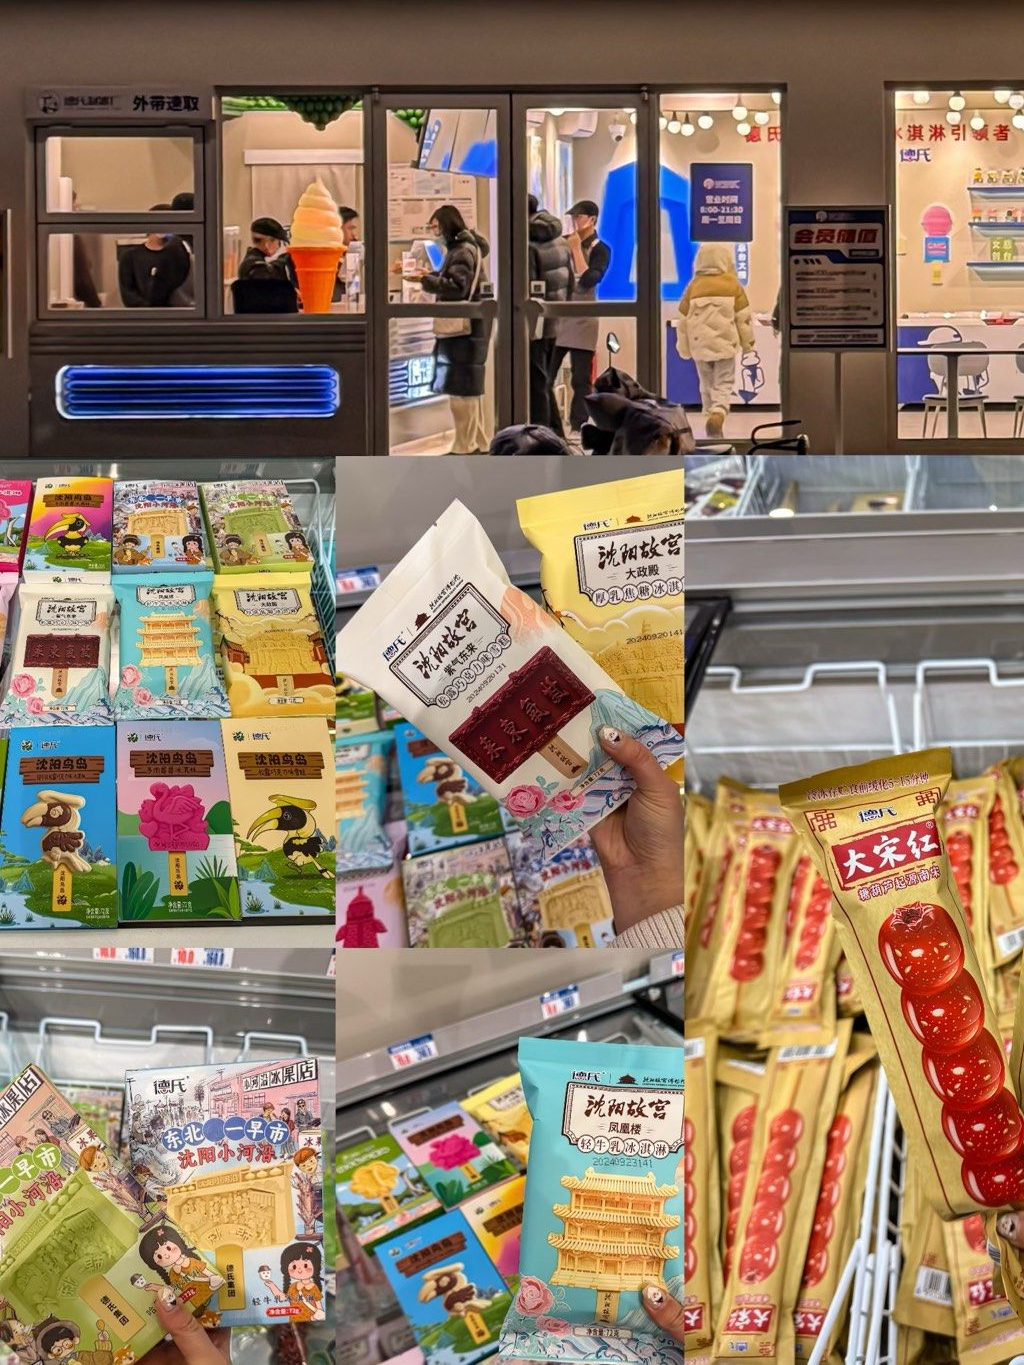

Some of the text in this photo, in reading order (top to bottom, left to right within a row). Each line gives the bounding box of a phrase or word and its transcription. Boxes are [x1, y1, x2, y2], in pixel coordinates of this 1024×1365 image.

[133, 95, 199, 112] 外带速取
[794, 229, 878, 243] 会员储值
[583, 520, 610, 531] 德氏
[597, 533, 683, 569] 沈阳故宫
[625, 564, 660, 580] 大政殿
[247, 590, 288, 602] 沈阳故宫
[46, 605, 87, 614] 沈阳故宫
[412, 608, 478, 679] 沈阳故宫
[625, 629, 683, 645] 20240920141
[382, 636, 407, 662] 德氏
[444, 643, 478, 676] 紫气东来
[436, 634, 511, 708] 松露巧克力味雪糕
[466, 664, 507, 703] 20240920131
[36, 758, 88, 770] 沈阳鸟岛
[146, 752, 197, 764] 沈阳鸟岛
[255, 754, 307, 766] 沈阳鸟岛
[858, 806, 898, 823] 德氏
[843, 830, 938, 880] 大宋红
[857, 864, 941, 902] 糖葫芦起源南宋
[242, 1058, 318, 1092] 小河沿冰果店
[572, 1070, 601, 1082] 德氏
[153, 1077, 187, 1095] 德氏
[584, 1095, 671, 1120] 沈阳故宫
[608, 1122, 642, 1135] 凤凰楼
[579, 1135, 670, 1159] 轻牛乳冰淇淋
[178, 1143, 276, 1169] 沈阳小河沿
[592, 1157, 653, 1169] 20240923141
[226, 1264, 236, 1298] 德氏集团
